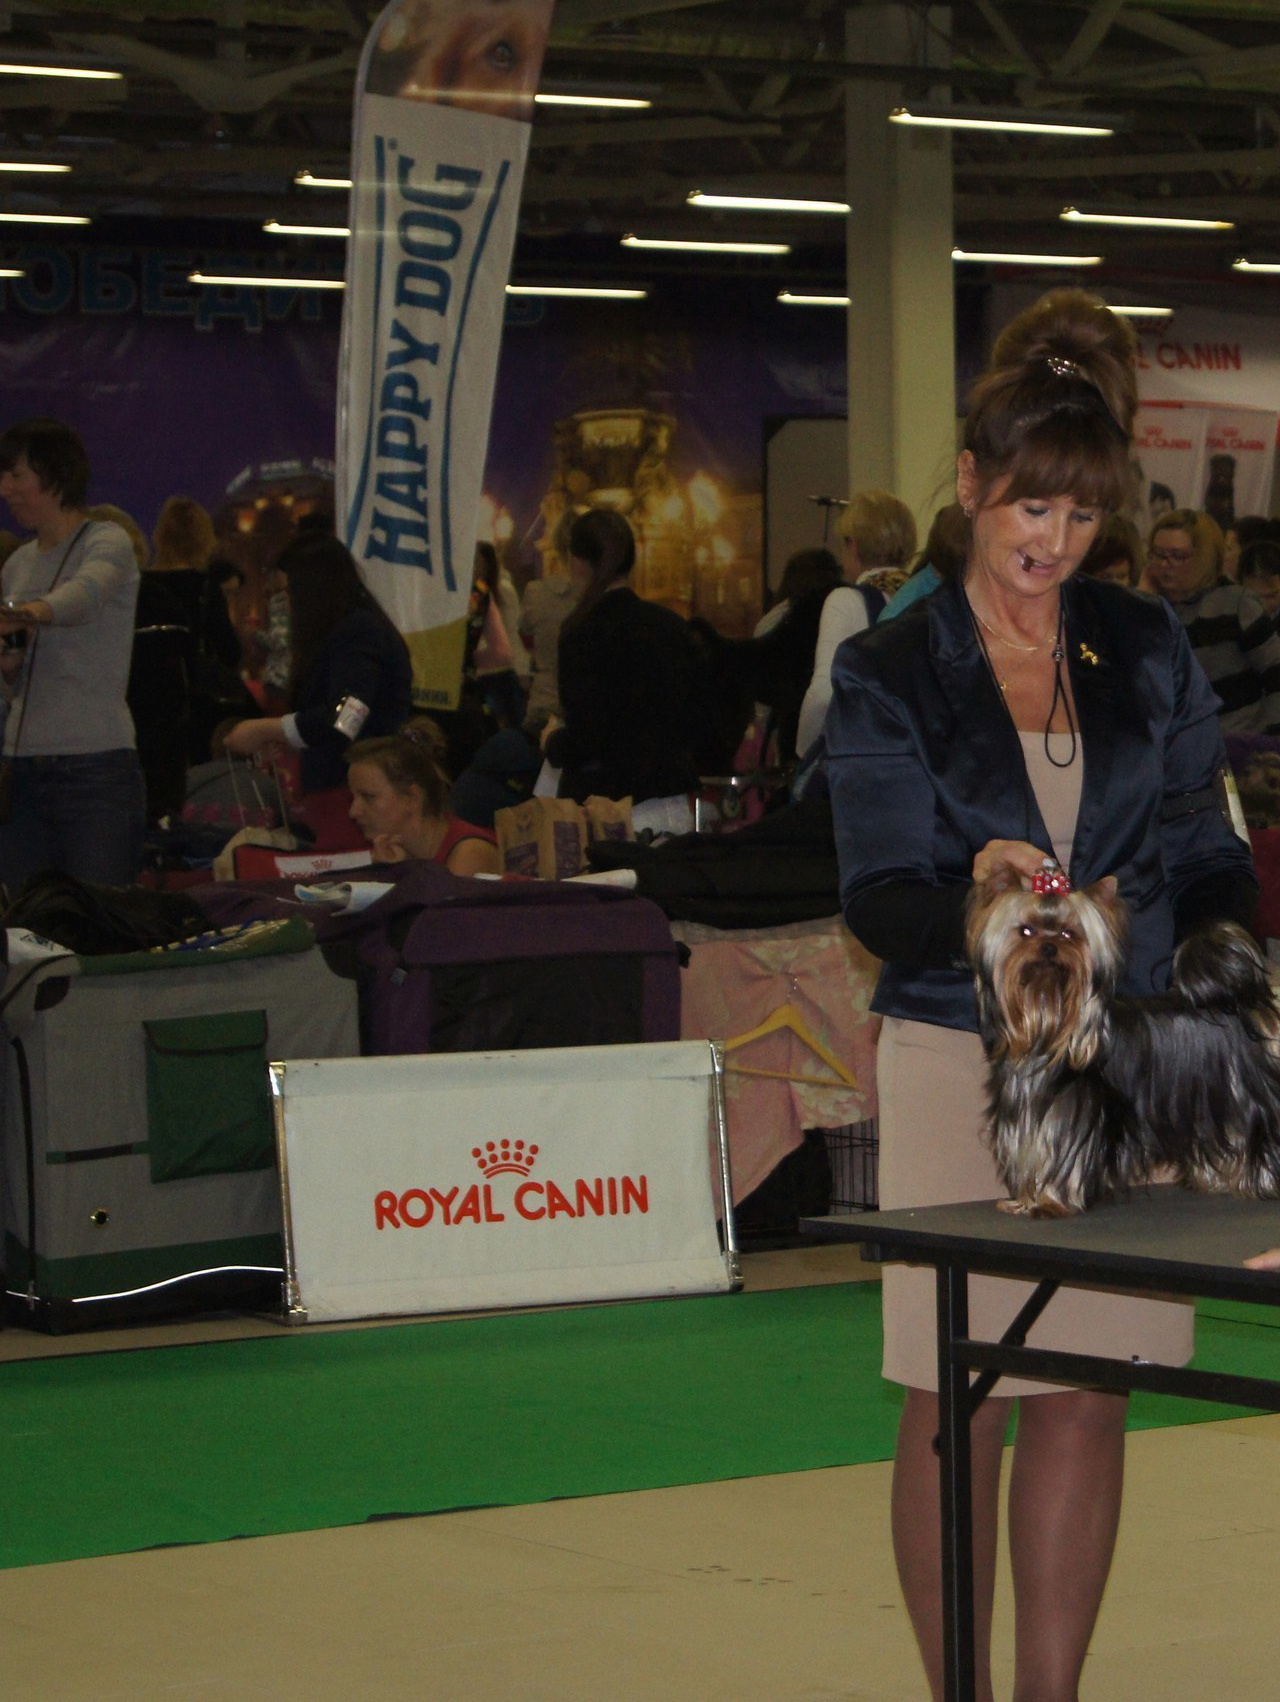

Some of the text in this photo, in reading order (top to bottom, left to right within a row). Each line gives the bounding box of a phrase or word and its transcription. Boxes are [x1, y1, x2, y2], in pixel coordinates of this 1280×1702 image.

[363, 154, 482, 575] HAPPY DOG
[1156, 342, 1241, 370] CANIN
[374, 1175, 648, 1230] ROYAL CANIN
